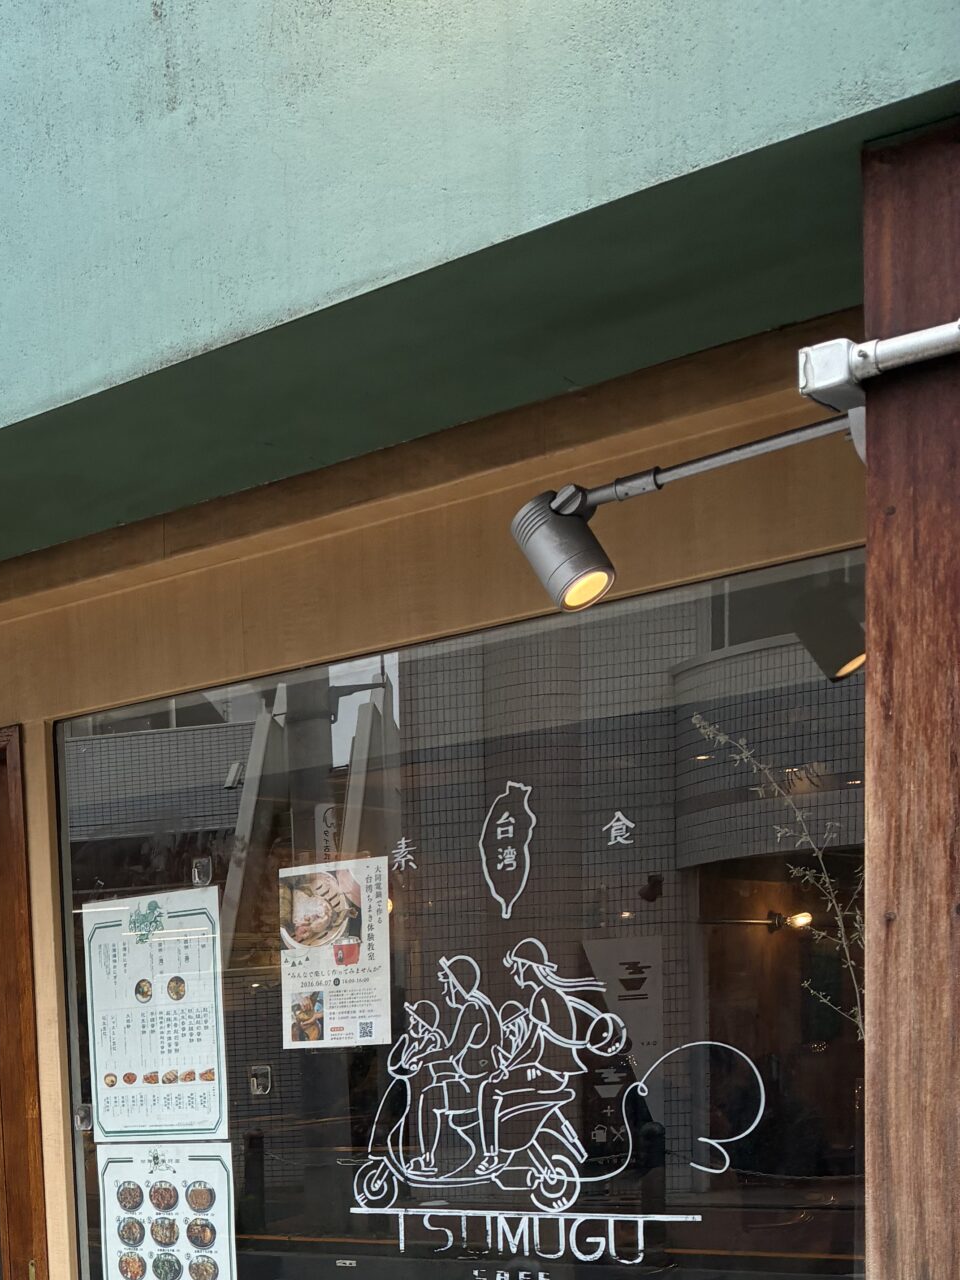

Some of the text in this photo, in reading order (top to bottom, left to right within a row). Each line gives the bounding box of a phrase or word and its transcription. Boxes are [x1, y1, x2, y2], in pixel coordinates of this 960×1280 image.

[391, 810, 636, 871] 素 食
[496, 811, 517, 871] 台湾
[397, 1211, 645, 1265] TSUMUGU
